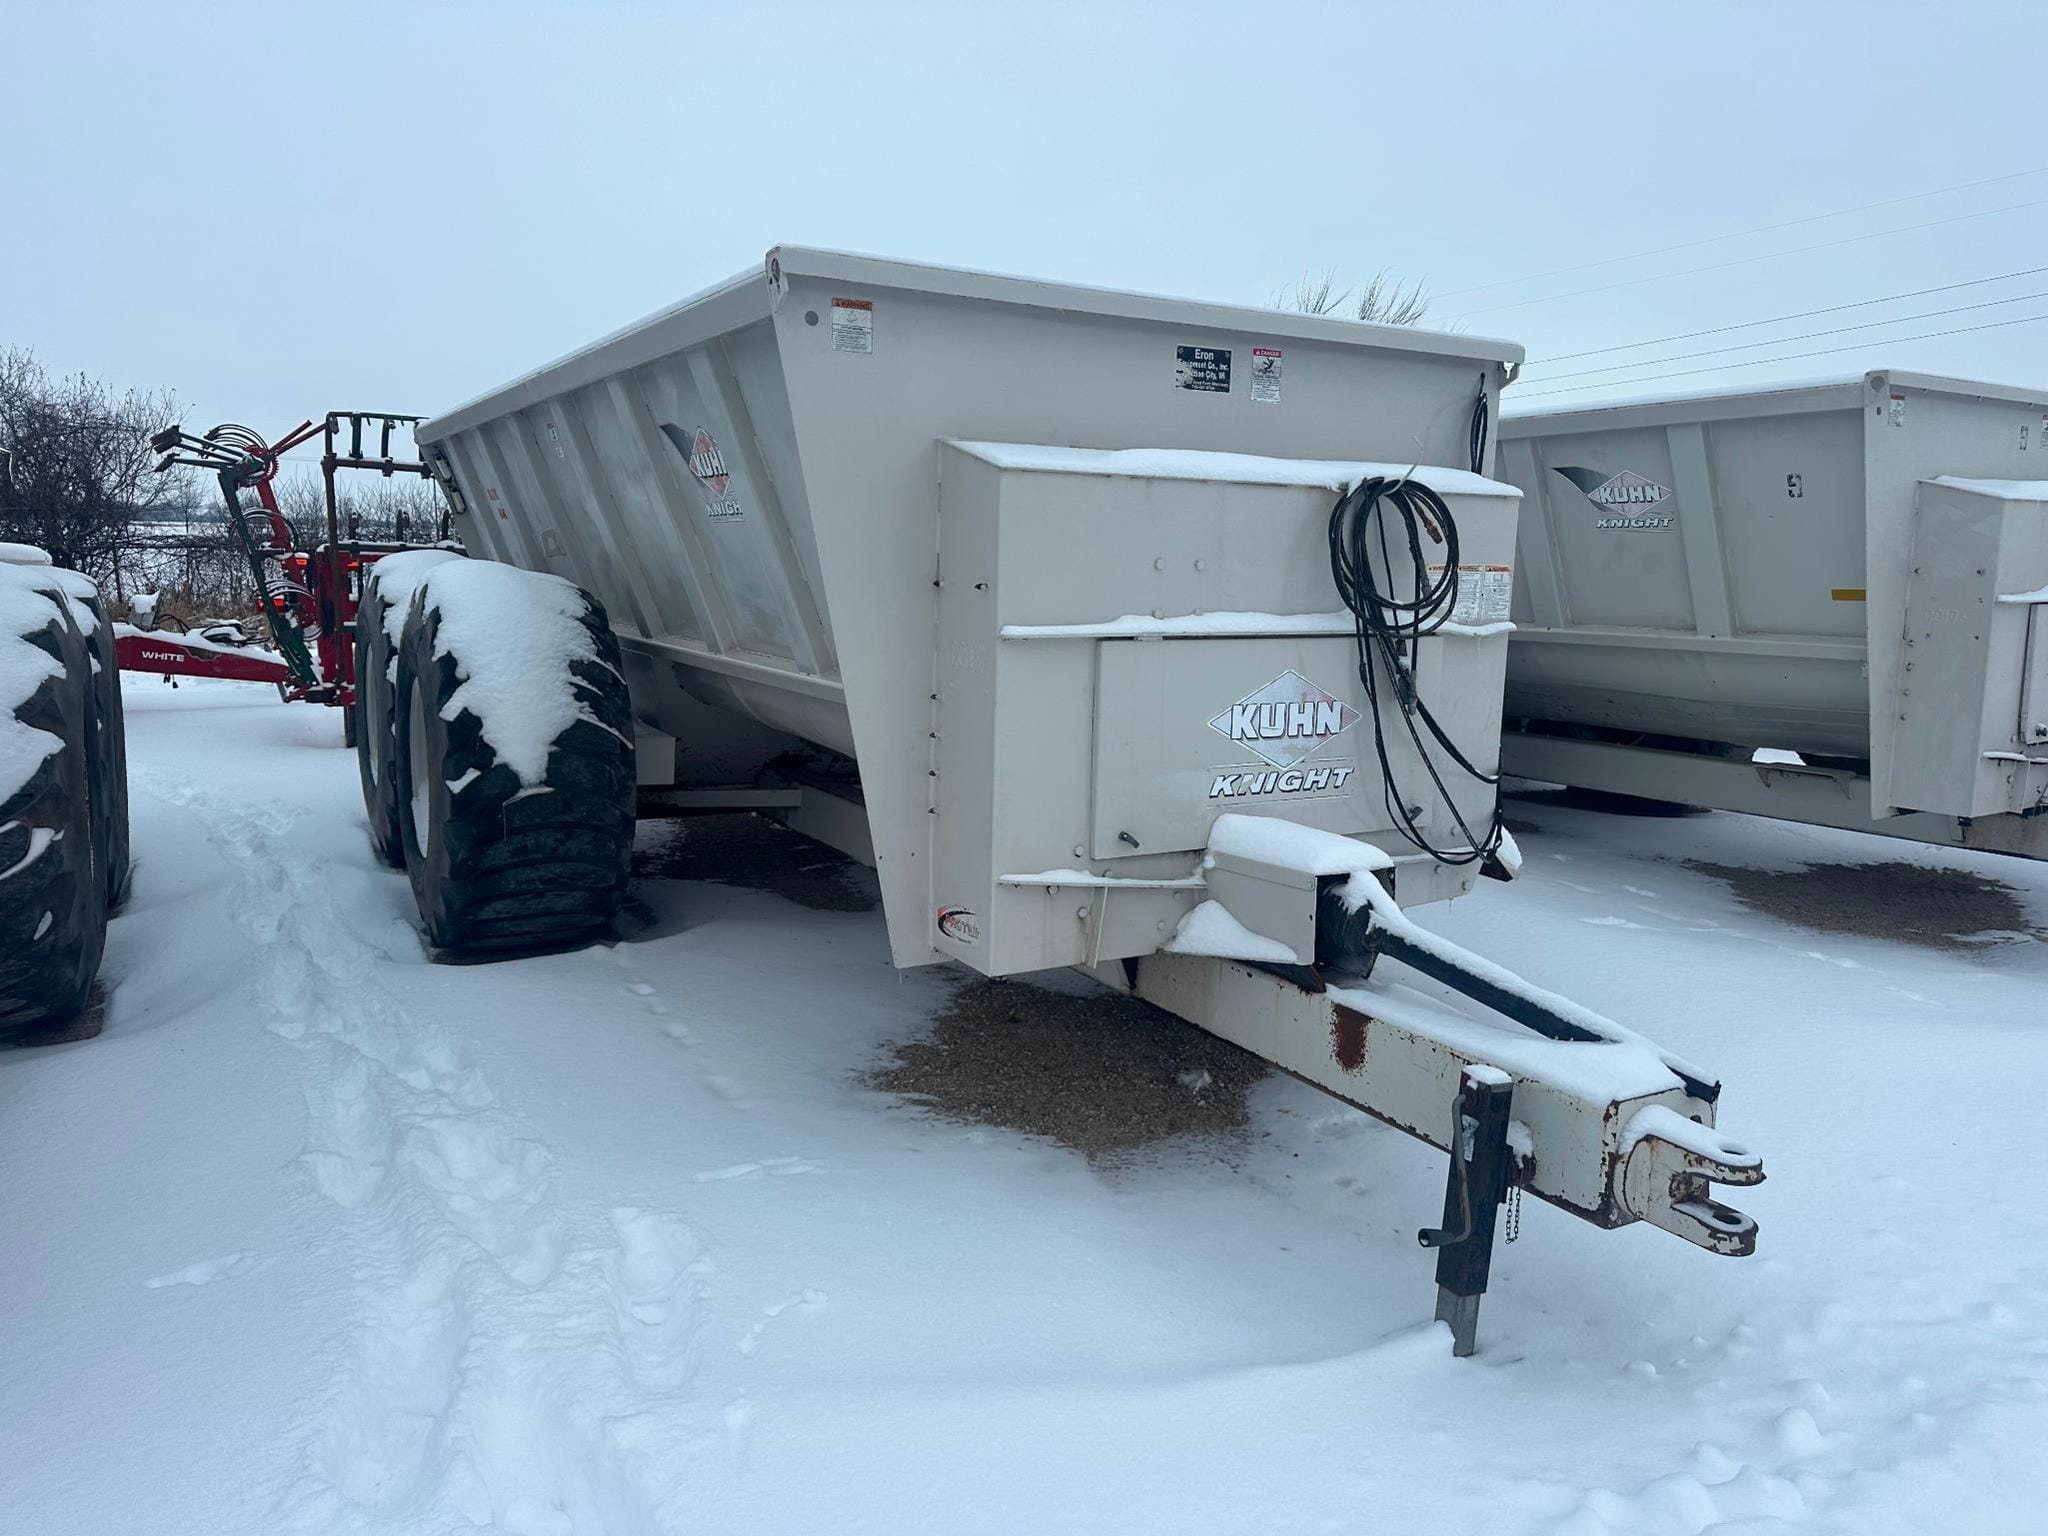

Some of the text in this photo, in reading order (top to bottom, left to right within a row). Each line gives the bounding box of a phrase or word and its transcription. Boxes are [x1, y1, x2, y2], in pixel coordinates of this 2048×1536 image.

[1194, 348, 1214, 360] Eron
[1599, 485, 1661, 504] KUHN
[1596, 518, 1674, 529] KNIGHT
[141, 651, 185, 662] WHITE
[1230, 700, 1343, 740] KUHN
[1209, 767, 1355, 798] KNIGHT
